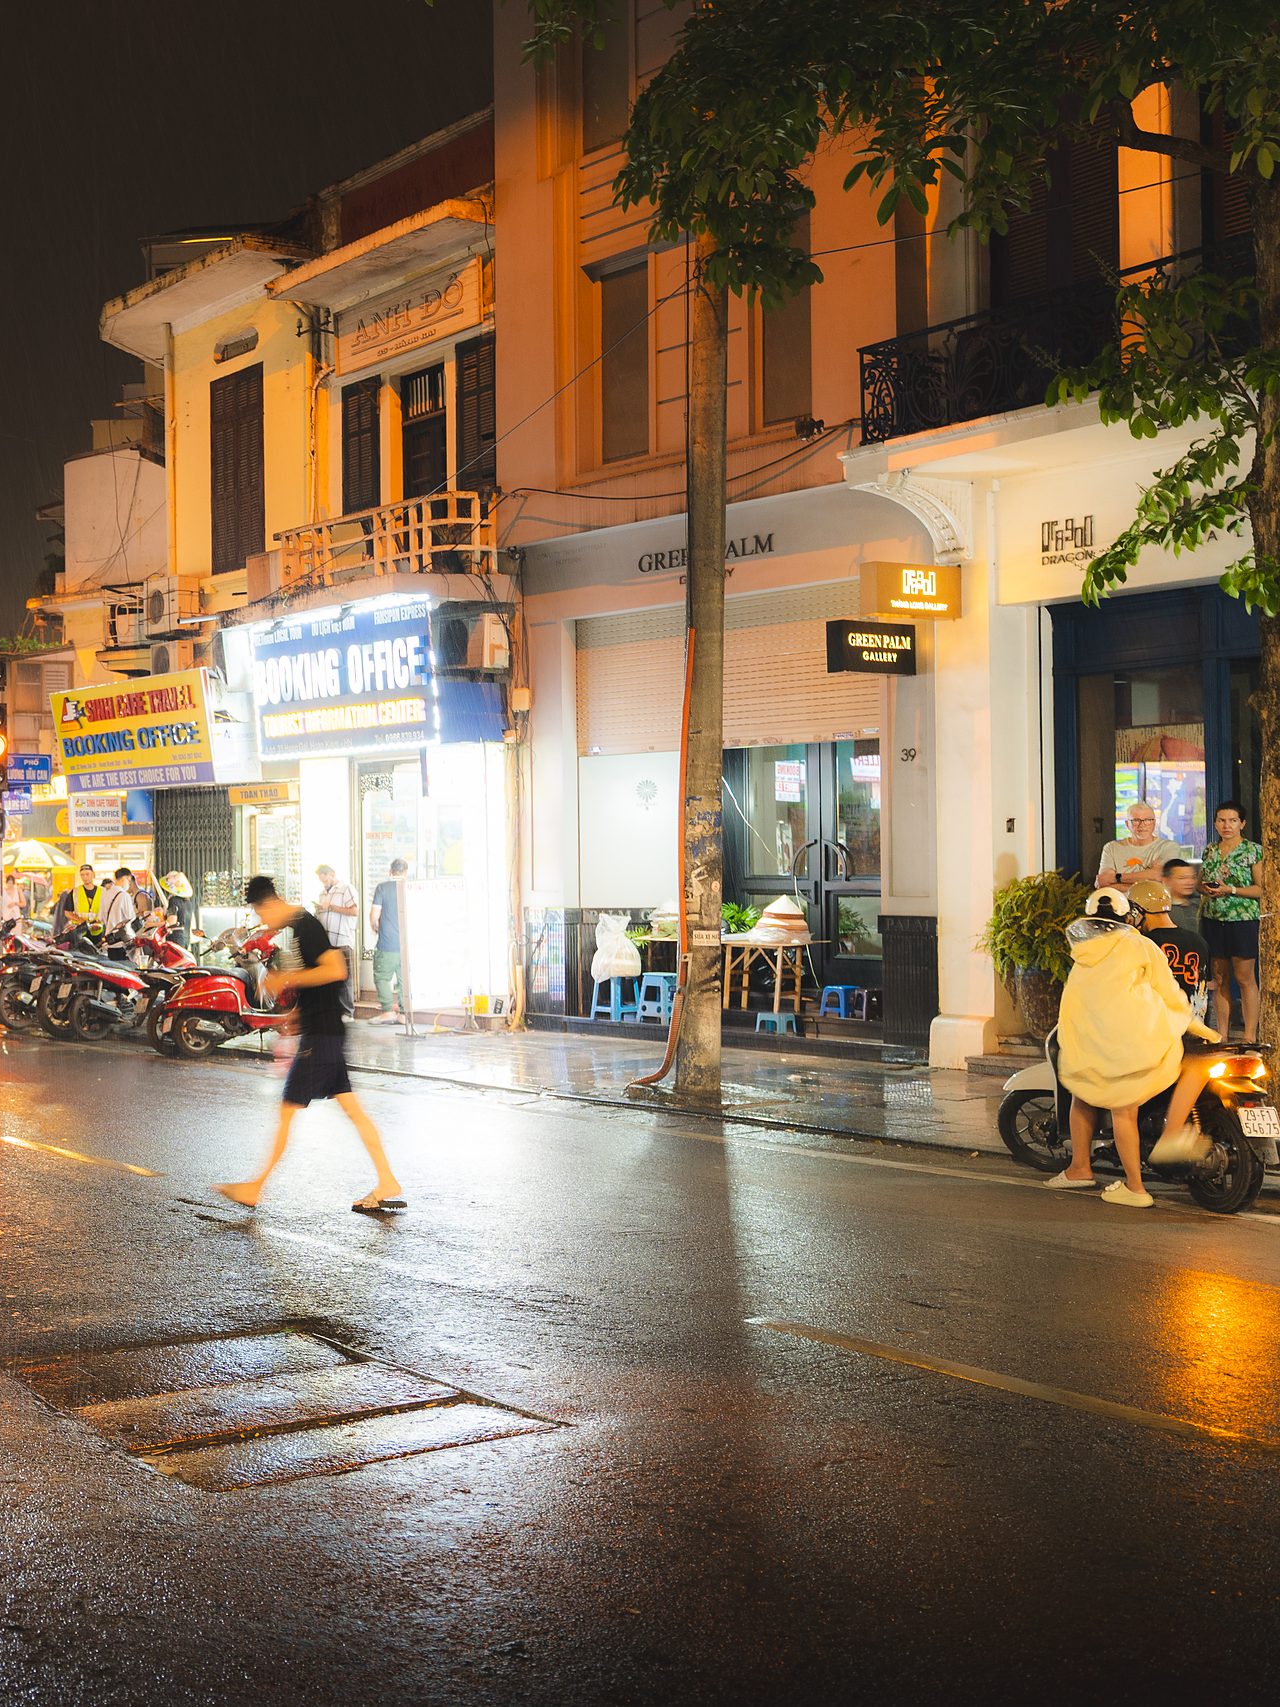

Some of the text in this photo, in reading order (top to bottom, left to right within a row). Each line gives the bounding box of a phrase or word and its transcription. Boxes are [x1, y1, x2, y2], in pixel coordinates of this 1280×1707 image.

[351, 299, 411, 348] ANH
[638, 548, 688, 573] GREE
[725, 533, 775, 560] ALM
[1041, 551, 1093, 566] DRAGON
[400, 602, 426, 621] EXPRESS
[848, 632, 911, 651] GREEN PALM
[862, 650, 897, 663] GALLERY
[254, 635, 428, 706] BOOKING OFFICE
[304, 702, 377, 733] INFORMATION
[62, 720, 201, 758] BOOKING OFFICE
[23, 756, 39, 766] PHỐ
[901, 748, 916, 762] 39
[79, 765, 197, 789] WE ARE THE BEST CHOICE FOR YOU
[1160, 943, 1200, 985] 23
[1244, 1109, 1273, 1121] 29-F1
[1244, 1122, 1280, 1135] 546.75
